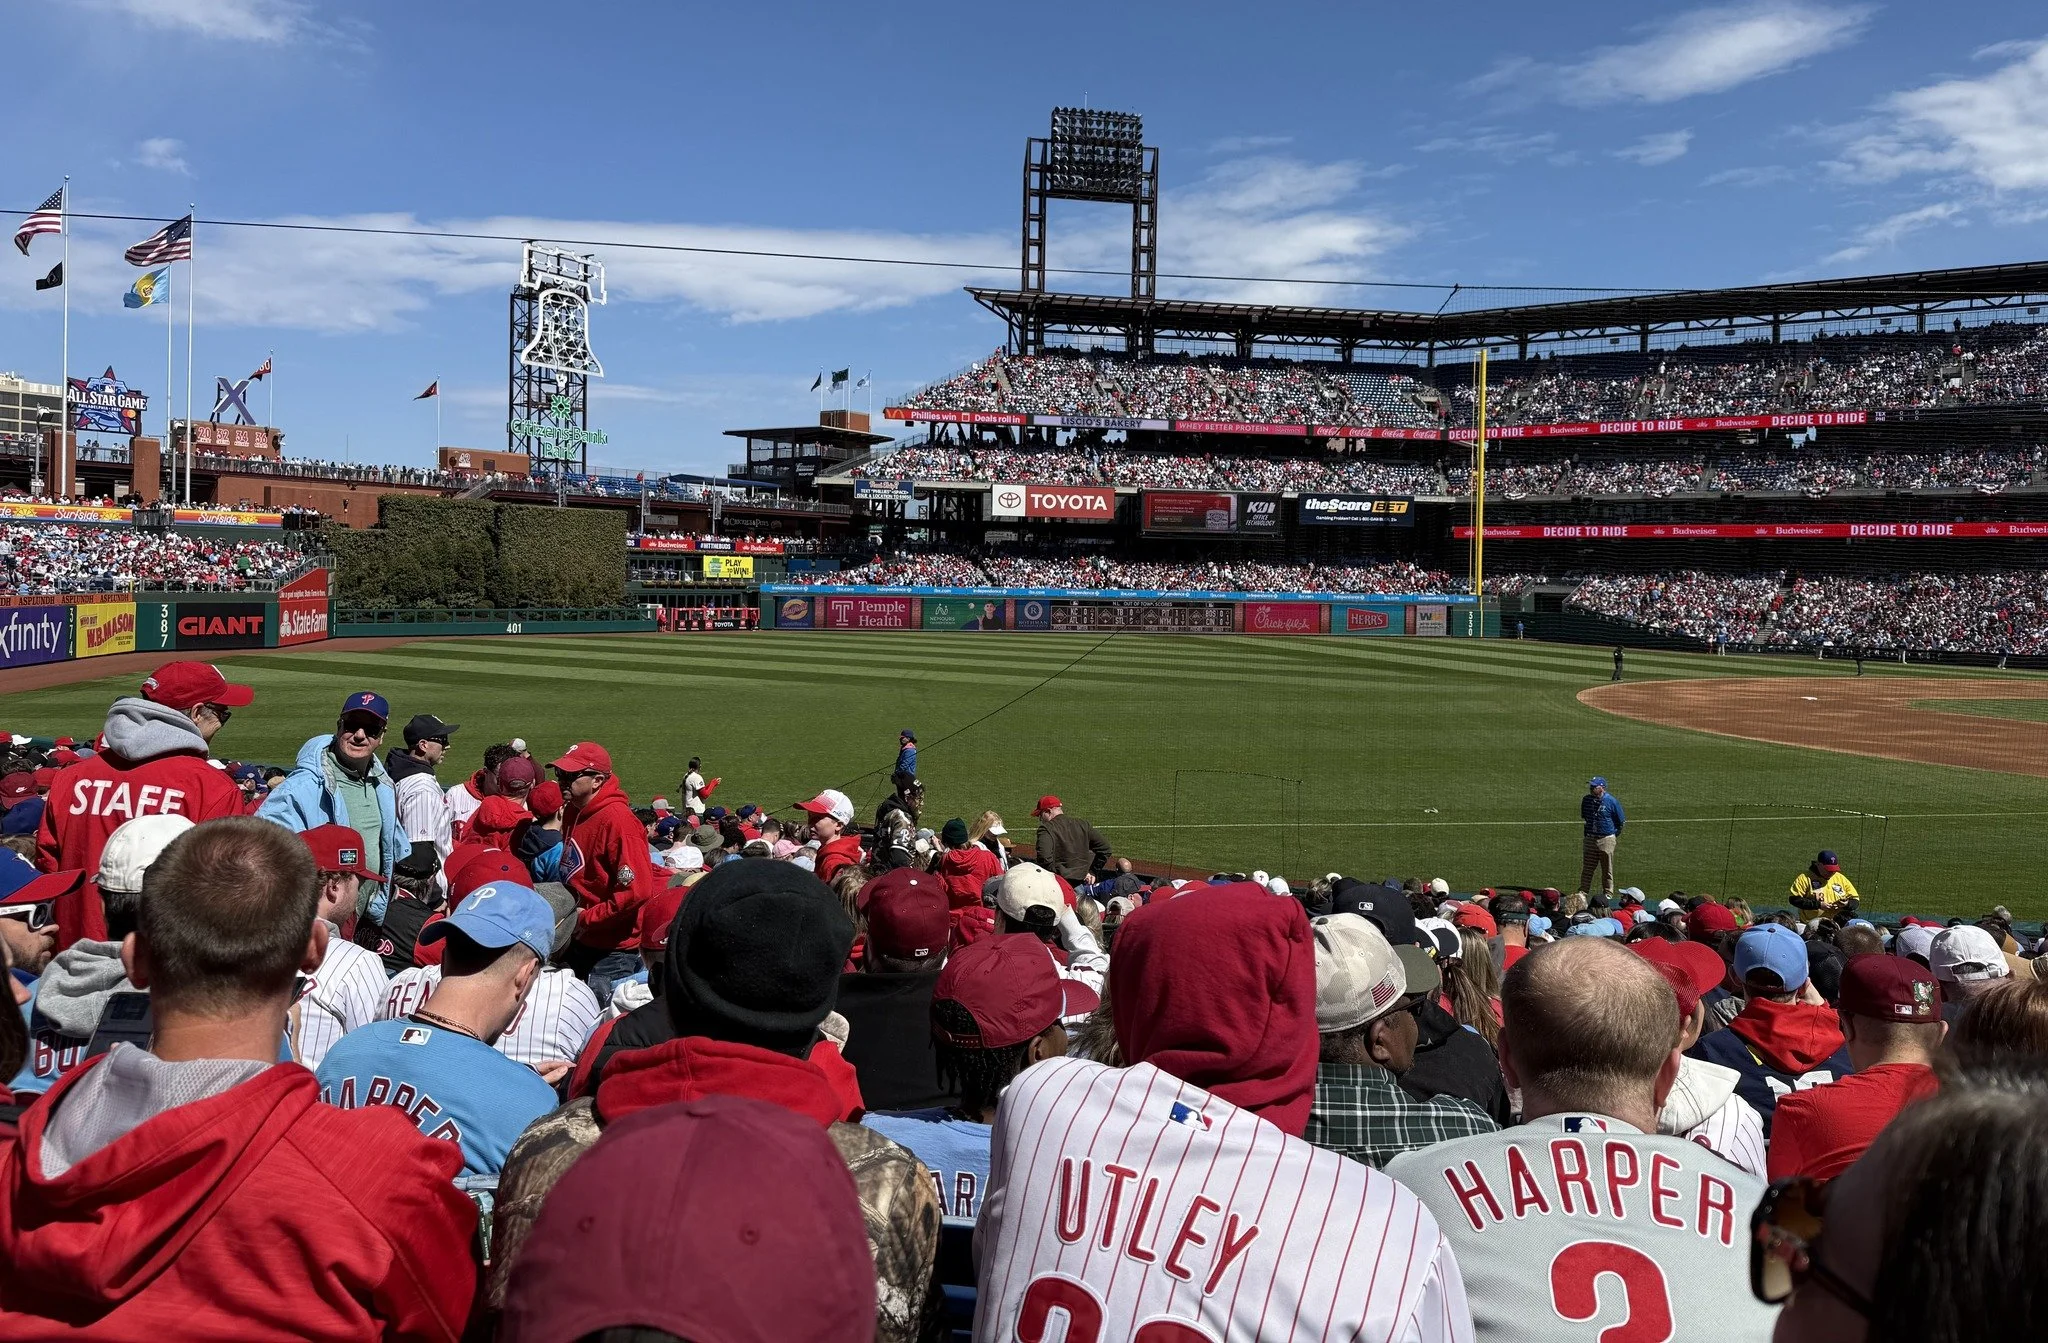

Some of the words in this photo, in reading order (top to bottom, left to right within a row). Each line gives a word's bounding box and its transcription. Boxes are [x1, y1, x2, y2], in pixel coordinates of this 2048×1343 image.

[90, 391, 118, 407] STAR
[119, 396, 147, 410] GAME
[911, 411, 940, 421] Phillies
[942, 413, 956, 421] win
[974, 414, 997, 422] Deals
[998, 415, 1010, 423] roll
[1061, 417, 1101, 427] LISCIO'S
[1104, 418, 1142, 428] BAKERY
[1716, 418, 1759, 428] Budweiser
[1772, 414, 1813, 426] DECIDE
[1818, 413, 1832, 424] TO
[1837, 412, 1865, 424] RIDE
[198, 427, 211, 439] 20
[511, 419, 570, 440] Citizens
[572, 425, 608, 445] Bank
[1180, 422, 1202, 430] WHEY
[1206, 423, 1232, 431] BETTER
[1236, 424, 1268, 432] PROTEIN
[1549, 425, 1589, 435] Budweiser
[1600, 421, 1639, 433] DECIDE
[1641, 421, 1654, 431] TO
[1658, 420, 1683, 431] RIDE
[216, 428, 229, 440] 32
[1448, 429, 1480, 441] DECID
[1486, 429, 1499, 438] TO
[1502, 427, 1524, 438] RIDE
[543, 441, 577, 459] Park
[1031, 493, 1107, 511] TOYOTA
[1305, 498, 1371, 511] theScore
[1375, 502, 1406, 512] BET
[54, 507, 99, 521] Surfside
[198, 512, 238, 525] Surfside
[1482, 528, 1521, 537] Budweiser
[1544, 526, 1582, 537] DECIDE
[1585, 526, 1598, 537] TO
[1602, 526, 1628, 537] RIDE
[1672, 527, 1717, 536] Budweiser
[1775, 526, 1823, 535] Budweiser
[1850, 524, 1897, 535] DECIDE
[1902, 524, 1917, 535] TO
[1922, 524, 1953, 535] RIDE
[658, 540, 687, 549] Budweiser
[700, 542, 731, 550] #HITTHEBUDS
[750, 544, 777, 552] Budweiser
[725, 559, 742, 567] PLAY
[18, 596, 55, 605] ASPLUNDH
[62, 594, 94, 604] ASPLUNDH
[100, 594, 129, 603] ASPLUNDH
[859, 600, 905, 613] Temple
[859, 616, 902, 627] Health
[1255, 606, 1310, 631] Chick-fil-A
[1352, 613, 1383, 626] HERR'S
[103, 613, 134, 642] MASON
[178, 616, 263, 636] GIANT
[506, 623, 522, 634] 401
[69, 778, 185, 818] STAFF
[466, 887, 497, 911] P
[320, 1075, 462, 1143] ARPER
[928, 1169, 990, 1218] AR
[1441, 1137, 1736, 1248] HARPER
[1055, 1156, 1260, 1297] UTLEY
